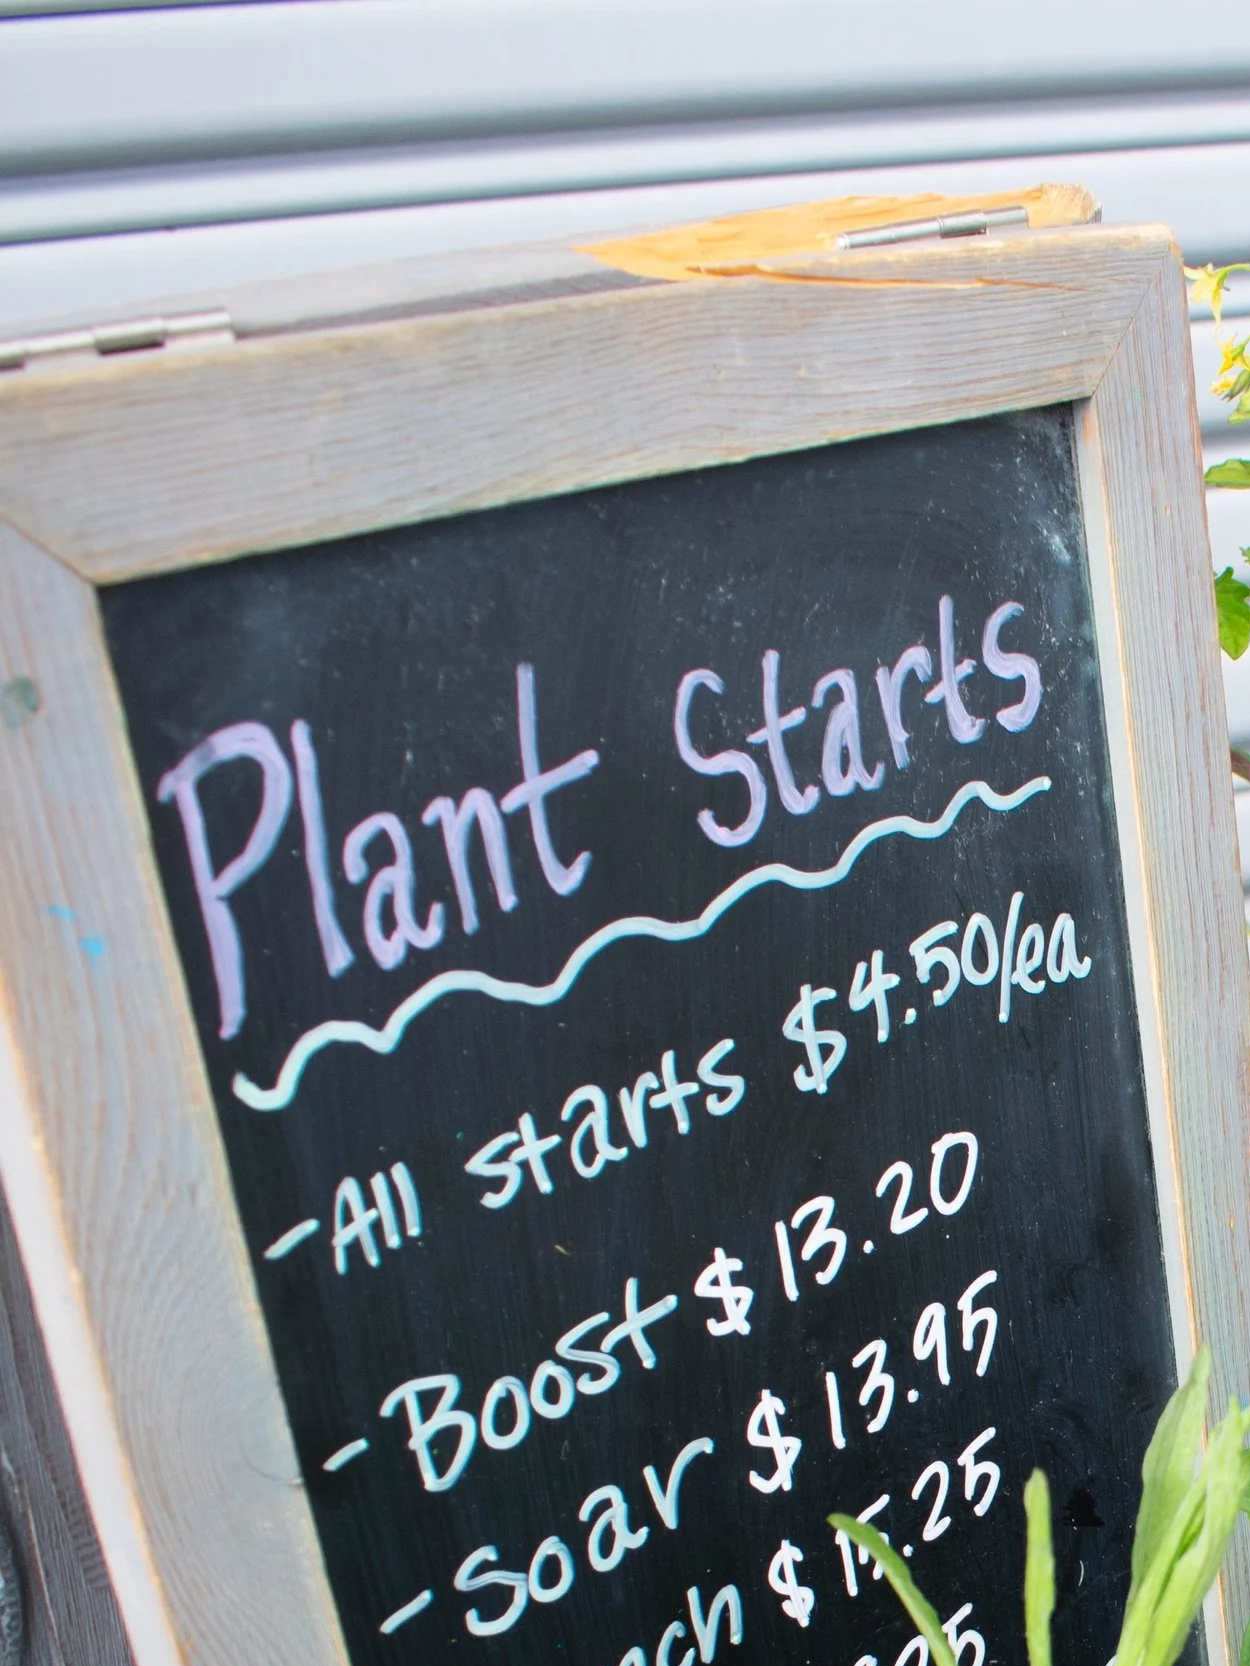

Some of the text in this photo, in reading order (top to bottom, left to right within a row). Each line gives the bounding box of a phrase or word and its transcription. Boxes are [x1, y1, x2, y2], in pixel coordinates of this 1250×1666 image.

[158, 594, 1044, 1040] Plant Starts
[465, 1037, 745, 1211] starts
[783, 890, 1093, 1096] $4.50/ea
